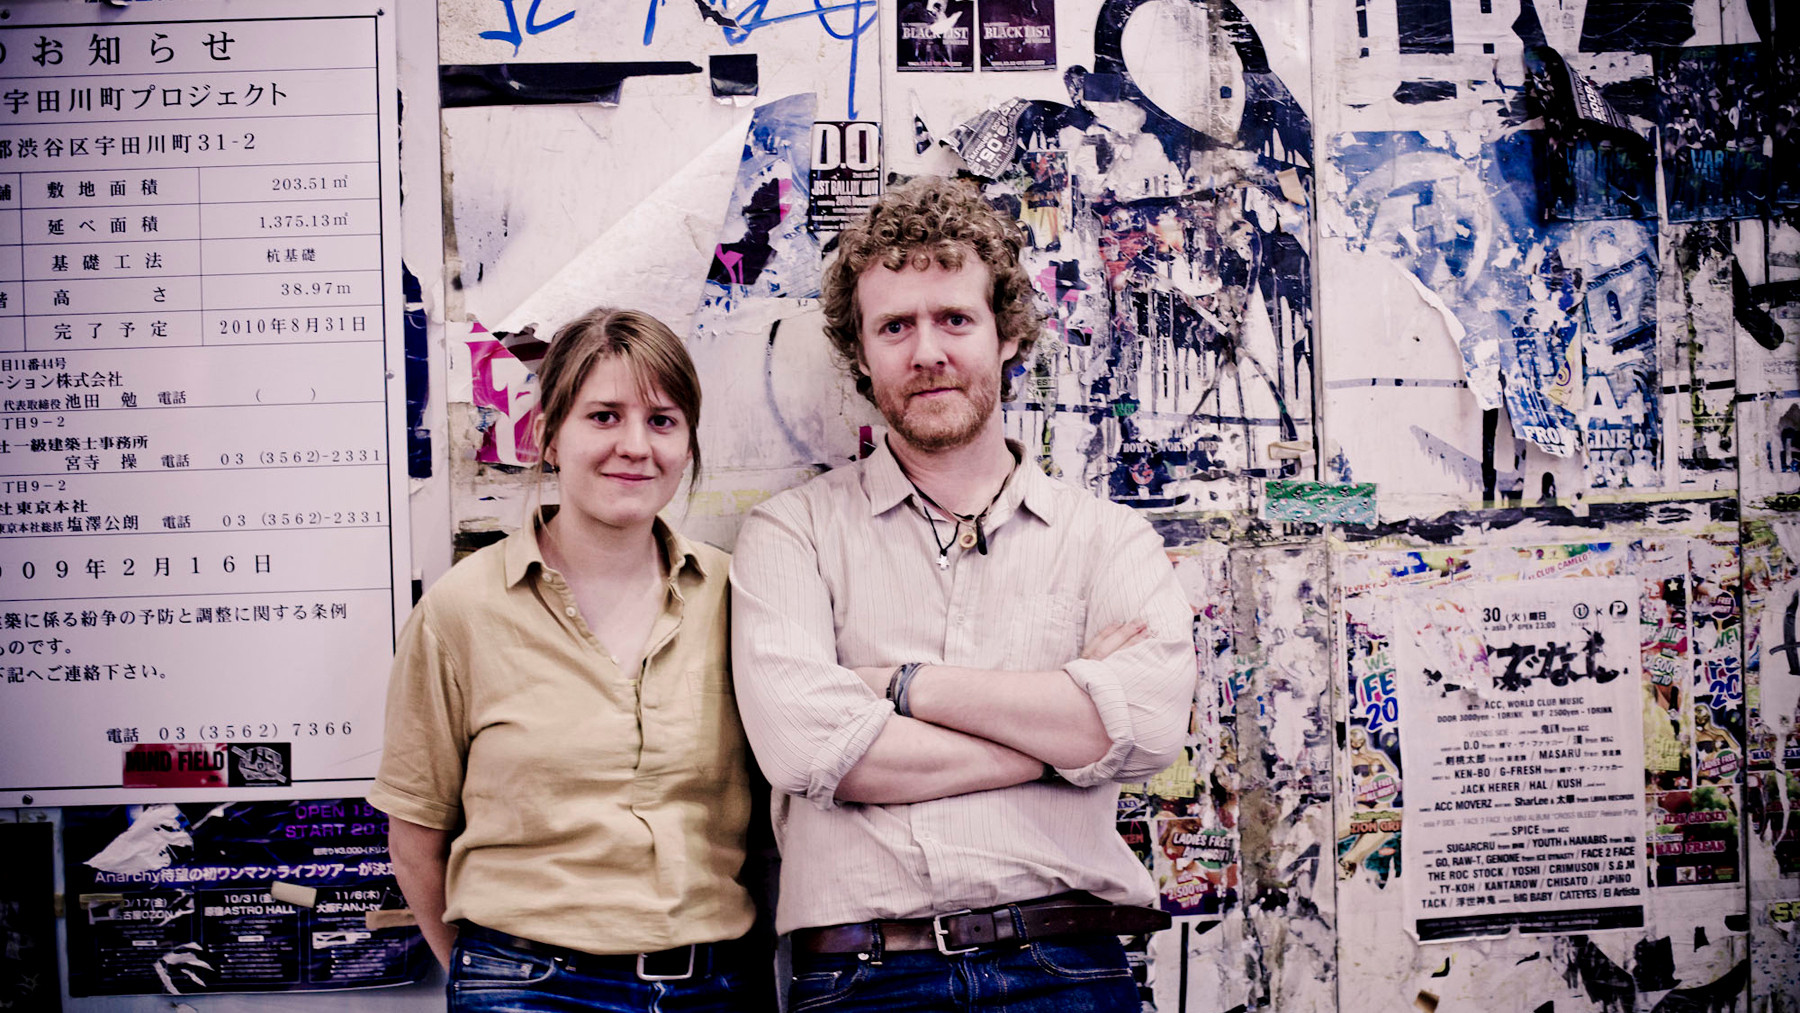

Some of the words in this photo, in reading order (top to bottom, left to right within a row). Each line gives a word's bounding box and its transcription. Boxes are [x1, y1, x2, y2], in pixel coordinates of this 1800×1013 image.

[983, 26, 1023, 39] BLACK
[1024, 25, 1050, 37] LIST
[0, 30, 236, 68] お知らせ
[3, 82, 288, 115] 宇田川町プロジェクト
[47, 180, 158, 200] 敷地面積
[47, 216, 158, 236] 延べ面積
[51, 253, 163, 272] 基礎工法
[53, 320, 169, 341] 完了予定
[219, 316, 367, 335] 2010年8月31日
[0, 371, 124, 390] ション株式会社
[157, 390, 187, 406] 電話
[160, 453, 191, 469] 電話
[162, 514, 192, 530] 電話
[0, 554, 272, 580] 09年2月16日
[0, 602, 348, 630] 築に係る紛争の予防と調整に関する条例
[1482, 606, 1500, 623] 30
[1507, 699, 1535, 709] WORLD
[1537, 697, 1557, 707] CLUB
[1559, 697, 1584, 706] MUSIC
[106, 727, 140, 743] 電話
[125, 751, 172, 772] MIND
[178, 750, 225, 771] FIELD
[1539, 748, 1581, 759] MASARU
[1454, 768, 1491, 779] KEN-BO
[1499, 765, 1542, 776] G-FRESH
[1460, 783, 1486, 794] JACK
[1488, 781, 1521, 792] HERER
[1529, 780, 1548, 790] HAL
[1557, 778, 1582, 788] KUSH
[295, 805, 346, 819] OPEN
[1434, 801, 1453, 811] ACC
[1455, 798, 1493, 810] MOVERZ
[285, 824, 346, 839] START
[1512, 825, 1540, 836] SPICE
[1173, 832, 1208, 847] LADIES
[1446, 841, 1496, 853] SUGARCRU
[1532, 837, 1562, 848] YOUTH
[1685, 840, 1726, 854] FREAK
[1581, 848, 1604, 858] FACE
[1613, 846, 1636, 856] FACE
[1428, 871, 1446, 881] THE
[1449, 869, 1469, 880] ROC
[1472, 867, 1504, 879] STOCK
[1512, 865, 1541, 876] YOSHI
[1440, 883, 1476, 894] TY-KOH
[1485, 879, 1538, 891] KANTAROW
[1547, 876, 1588, 888] CHISATO
[1422, 898, 1447, 909] TACK
[1529, 891, 1553, 902] BABY
[1559, 889, 1598, 900] CATEYES
